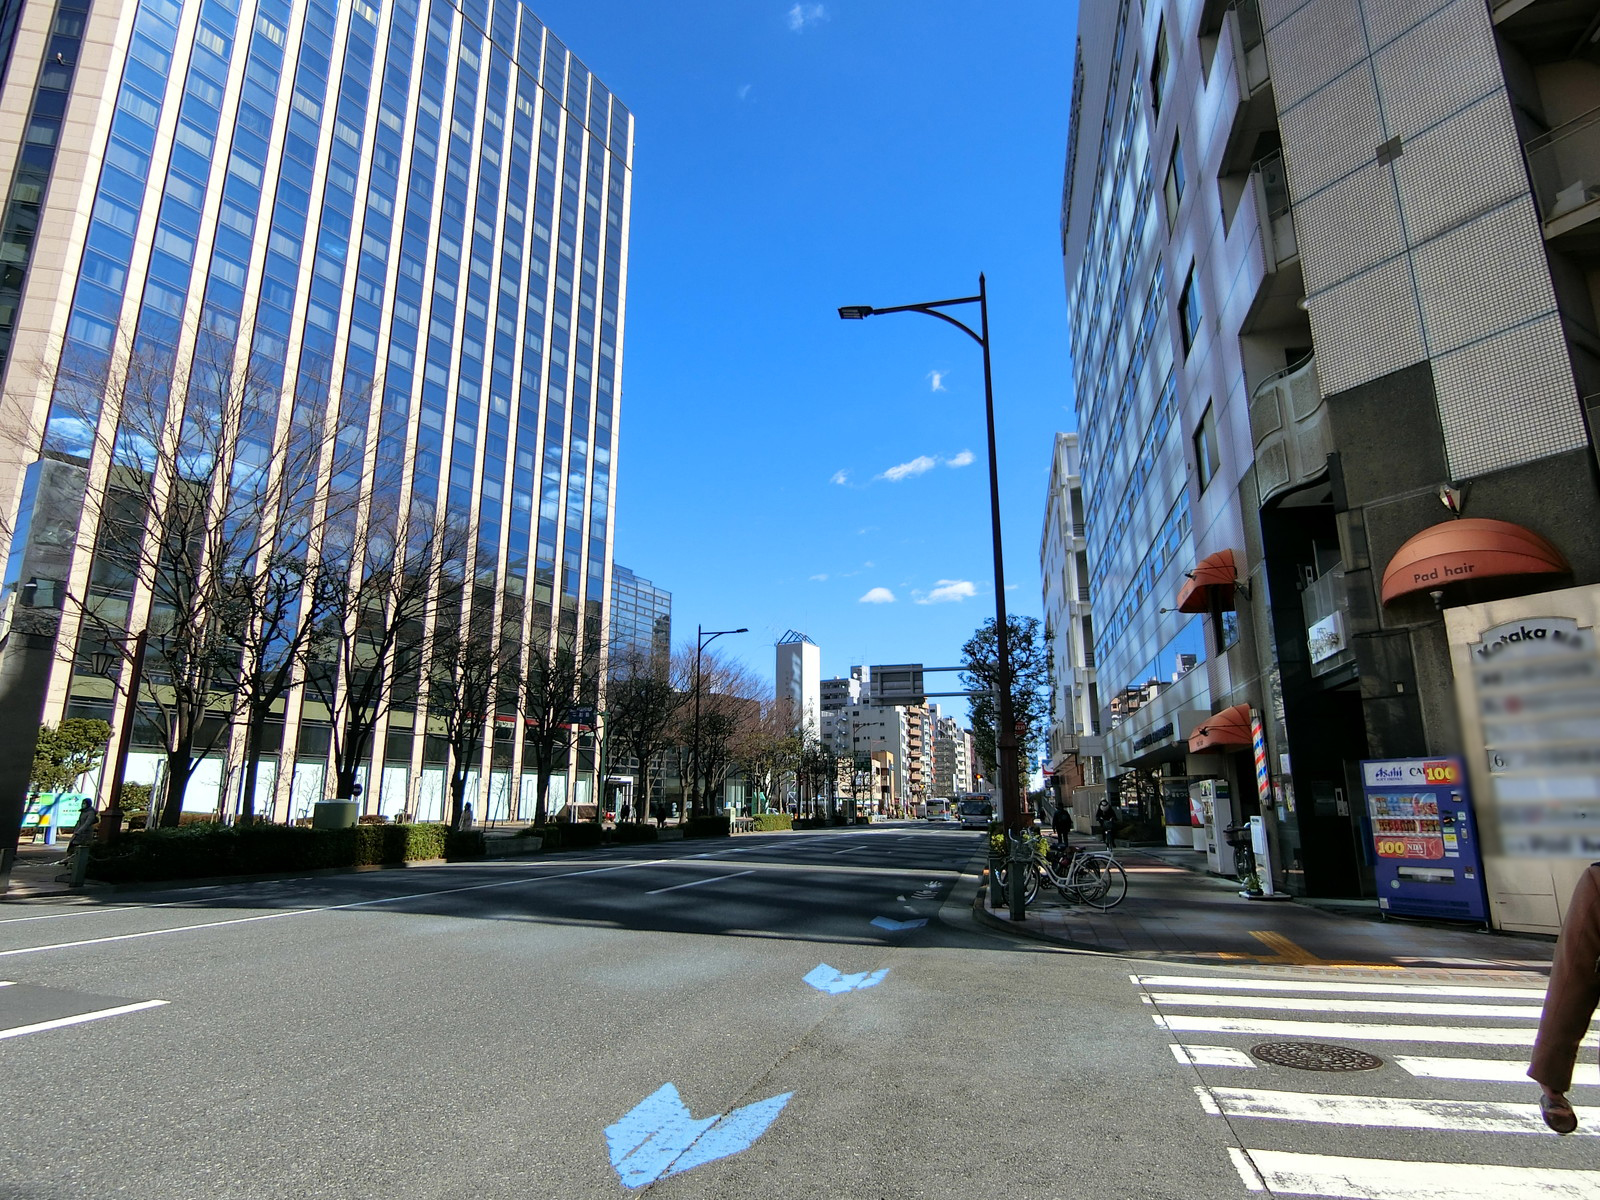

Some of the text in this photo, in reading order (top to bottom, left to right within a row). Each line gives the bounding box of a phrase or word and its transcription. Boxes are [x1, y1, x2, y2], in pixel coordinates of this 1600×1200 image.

[1414, 563, 1475, 583] Pad hair
[1375, 766, 1402, 778] Asahi
[1427, 767, 1456, 780] 100
[1378, 841, 1405, 854] 100
